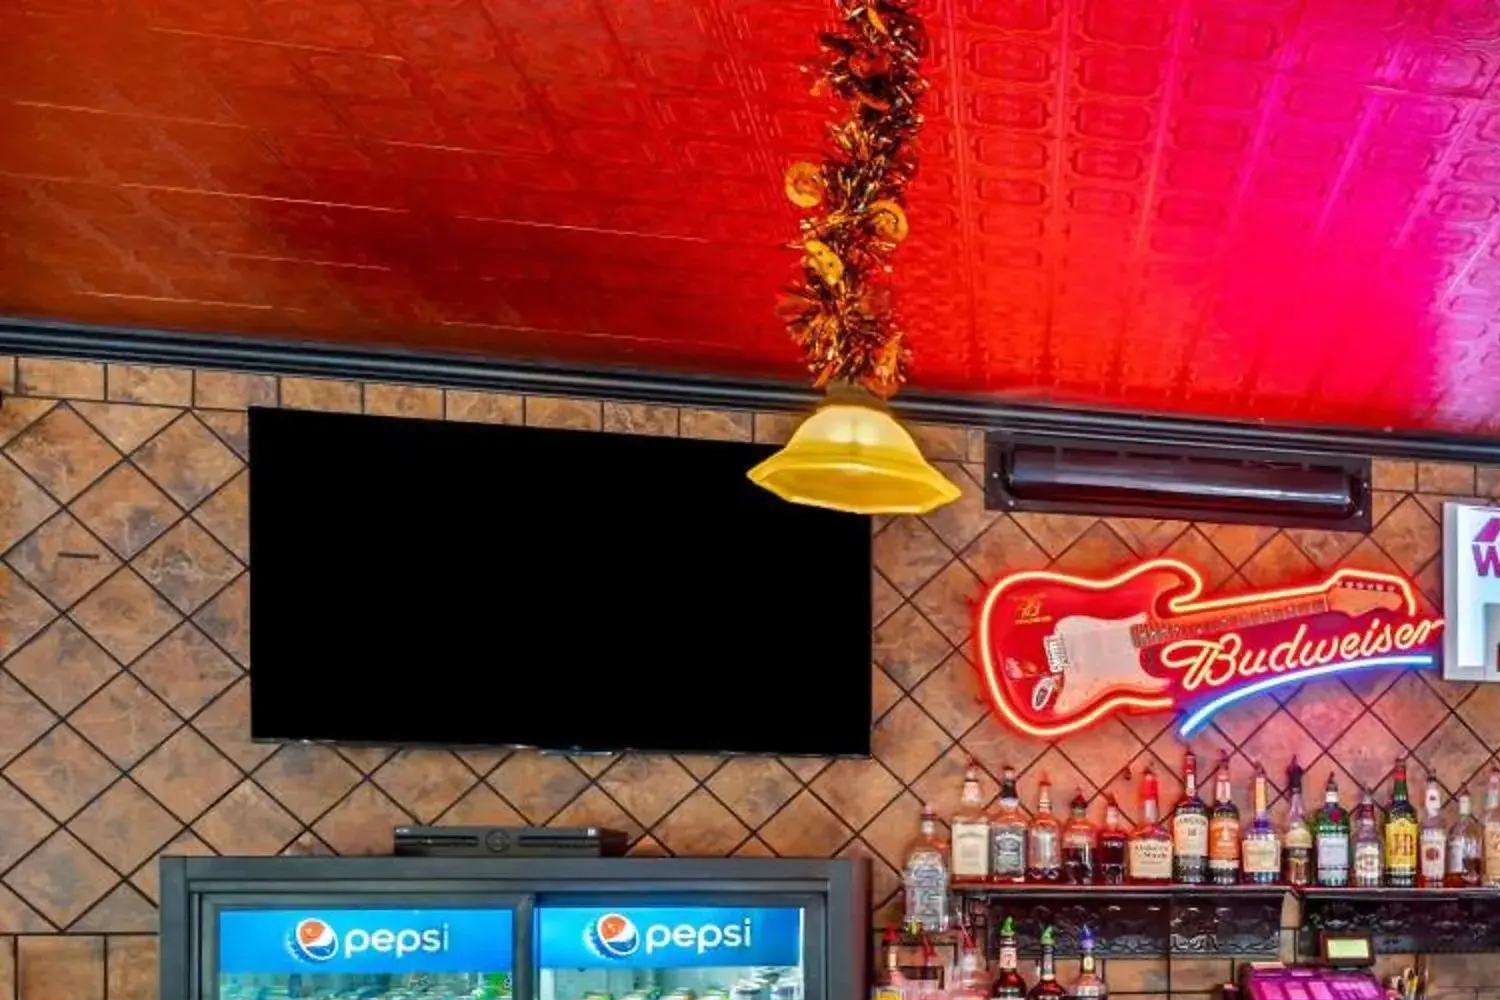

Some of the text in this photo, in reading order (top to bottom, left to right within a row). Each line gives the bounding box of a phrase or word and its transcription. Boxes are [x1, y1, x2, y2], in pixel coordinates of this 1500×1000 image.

[1160, 617, 1445, 691] Budweiser
[344, 922, 449, 959] pepsi
[645, 917, 752, 955] pepsi
